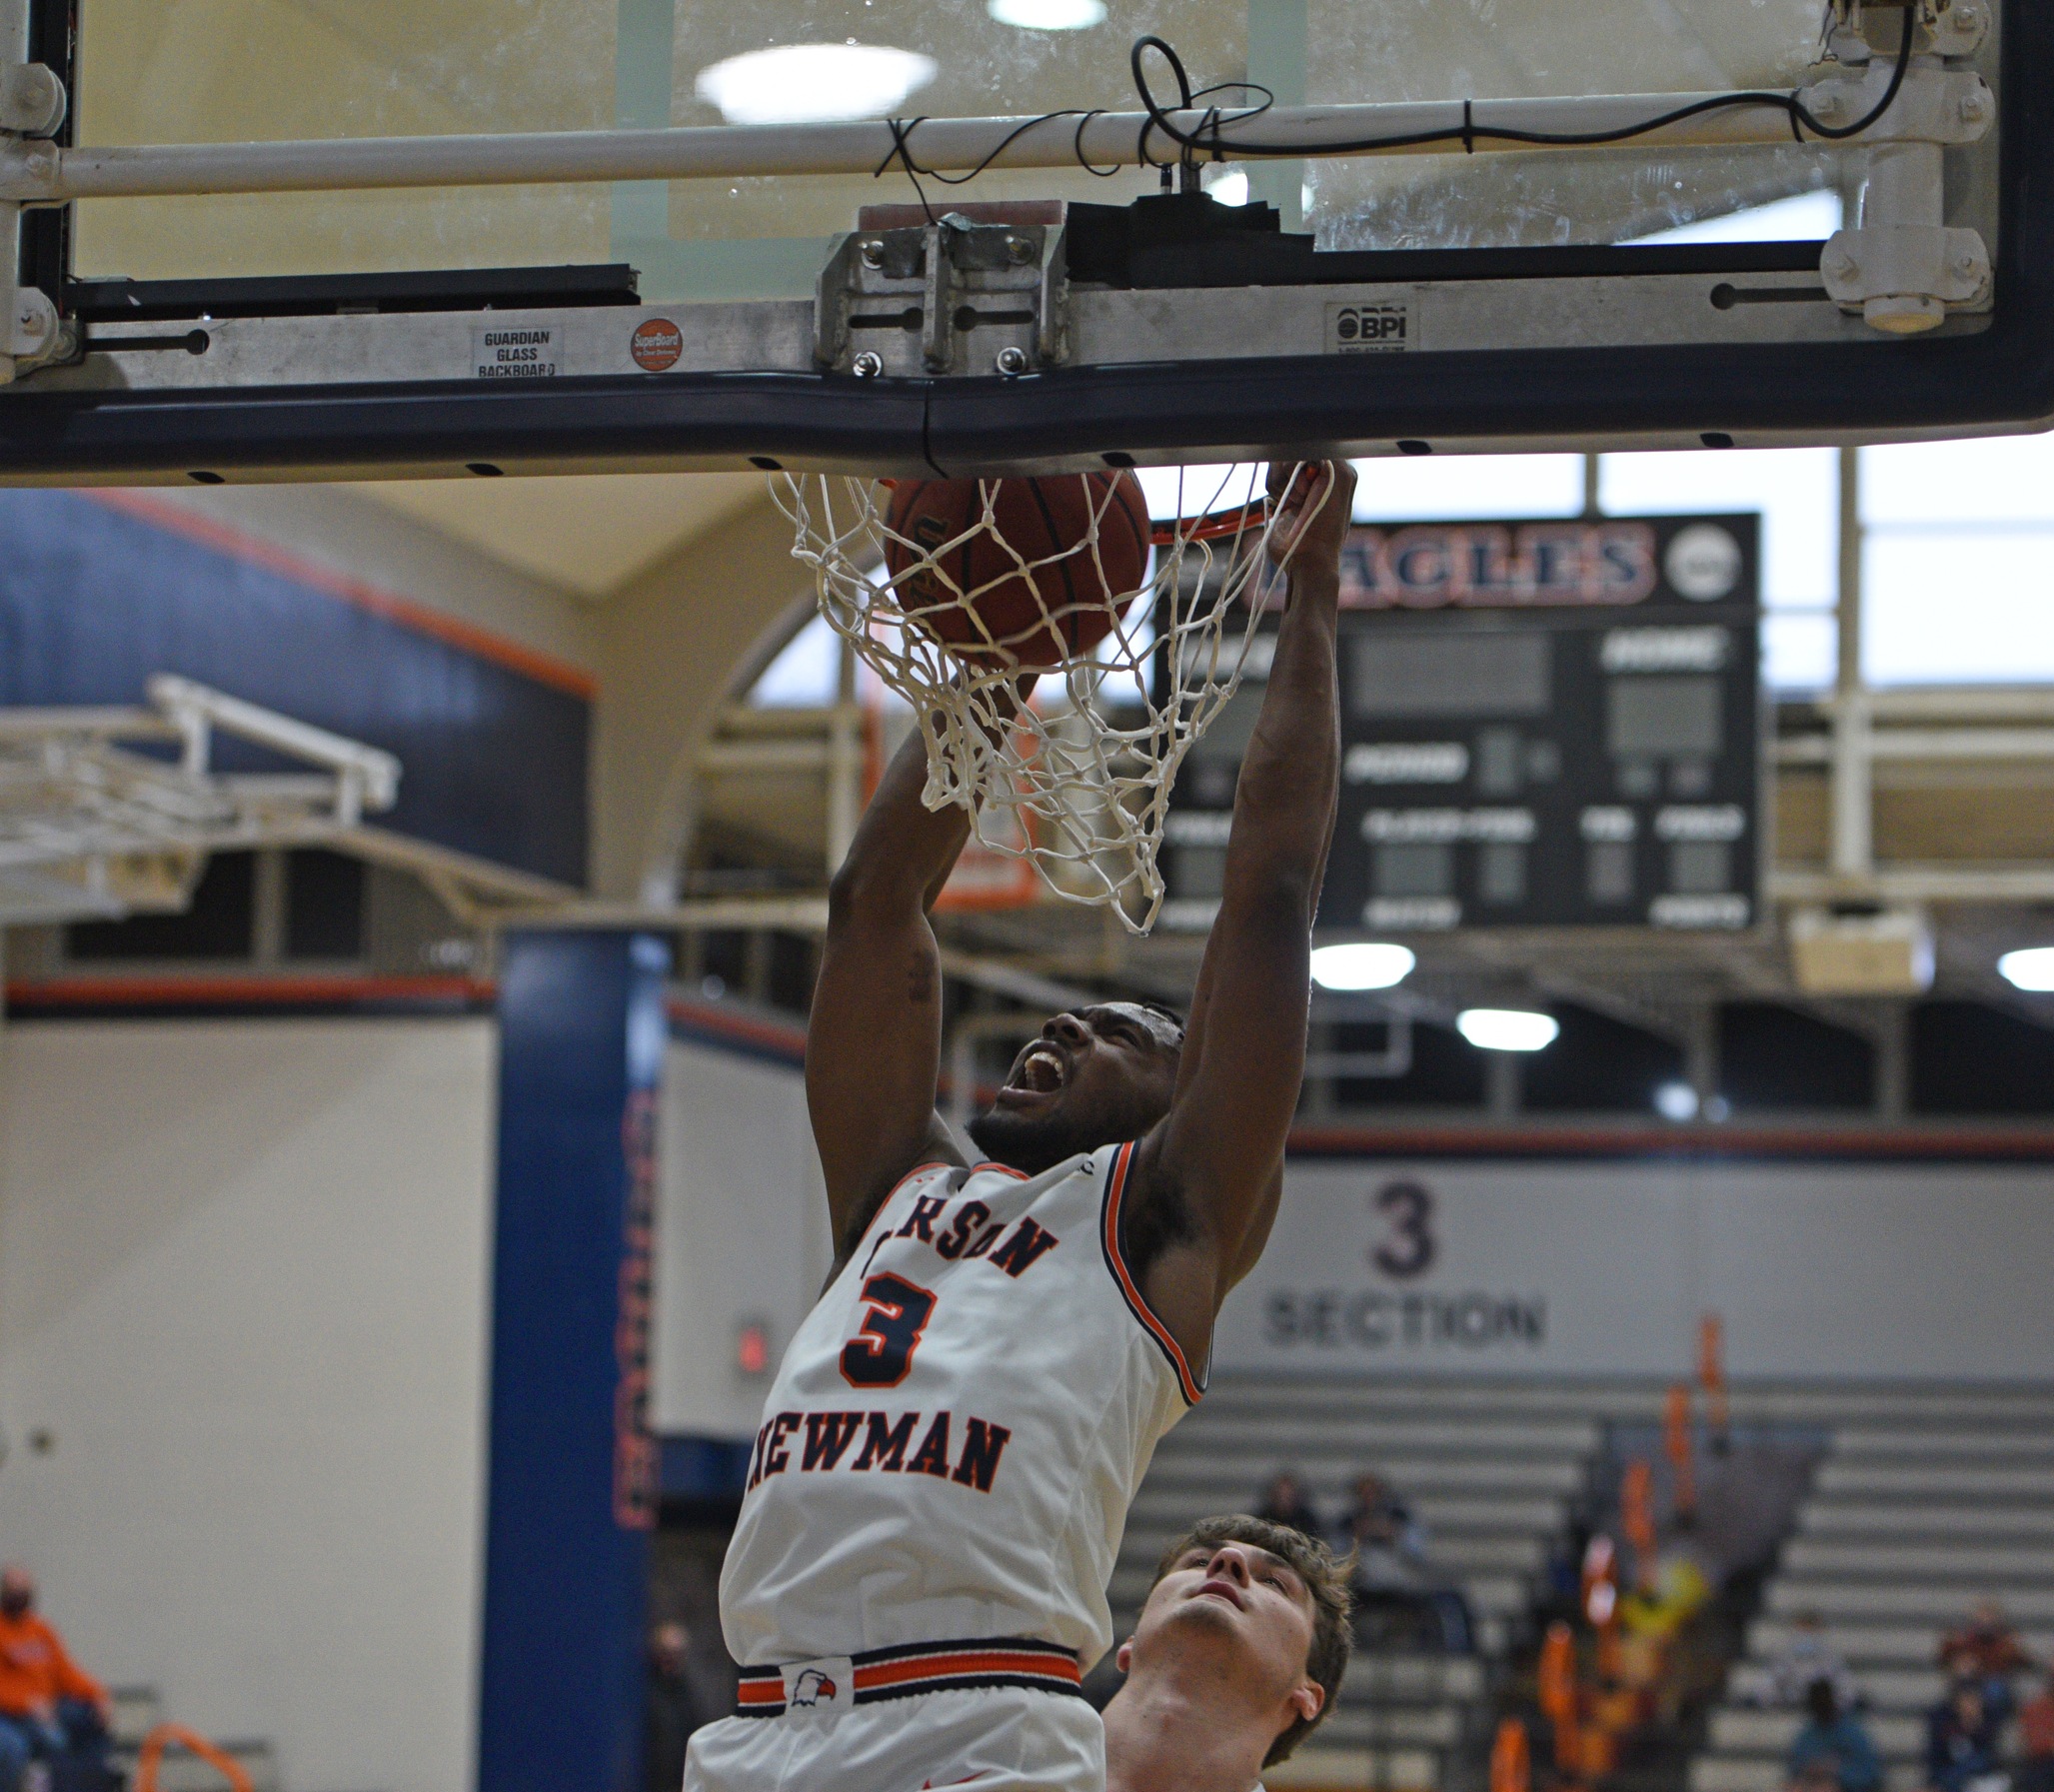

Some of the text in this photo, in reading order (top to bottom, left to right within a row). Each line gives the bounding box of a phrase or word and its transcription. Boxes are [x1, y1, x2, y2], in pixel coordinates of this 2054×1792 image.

[484, 331, 550, 346] GUARDIAN
[1360, 316, 1406, 339] BPI
[634, 332, 680, 349] SuperBoard
[496, 347, 539, 362] GLASS
[1370, 1177, 1438, 1280] 3
[839, 1270, 939, 1388] 3
[1262, 1291, 1547, 1346] SECTION
